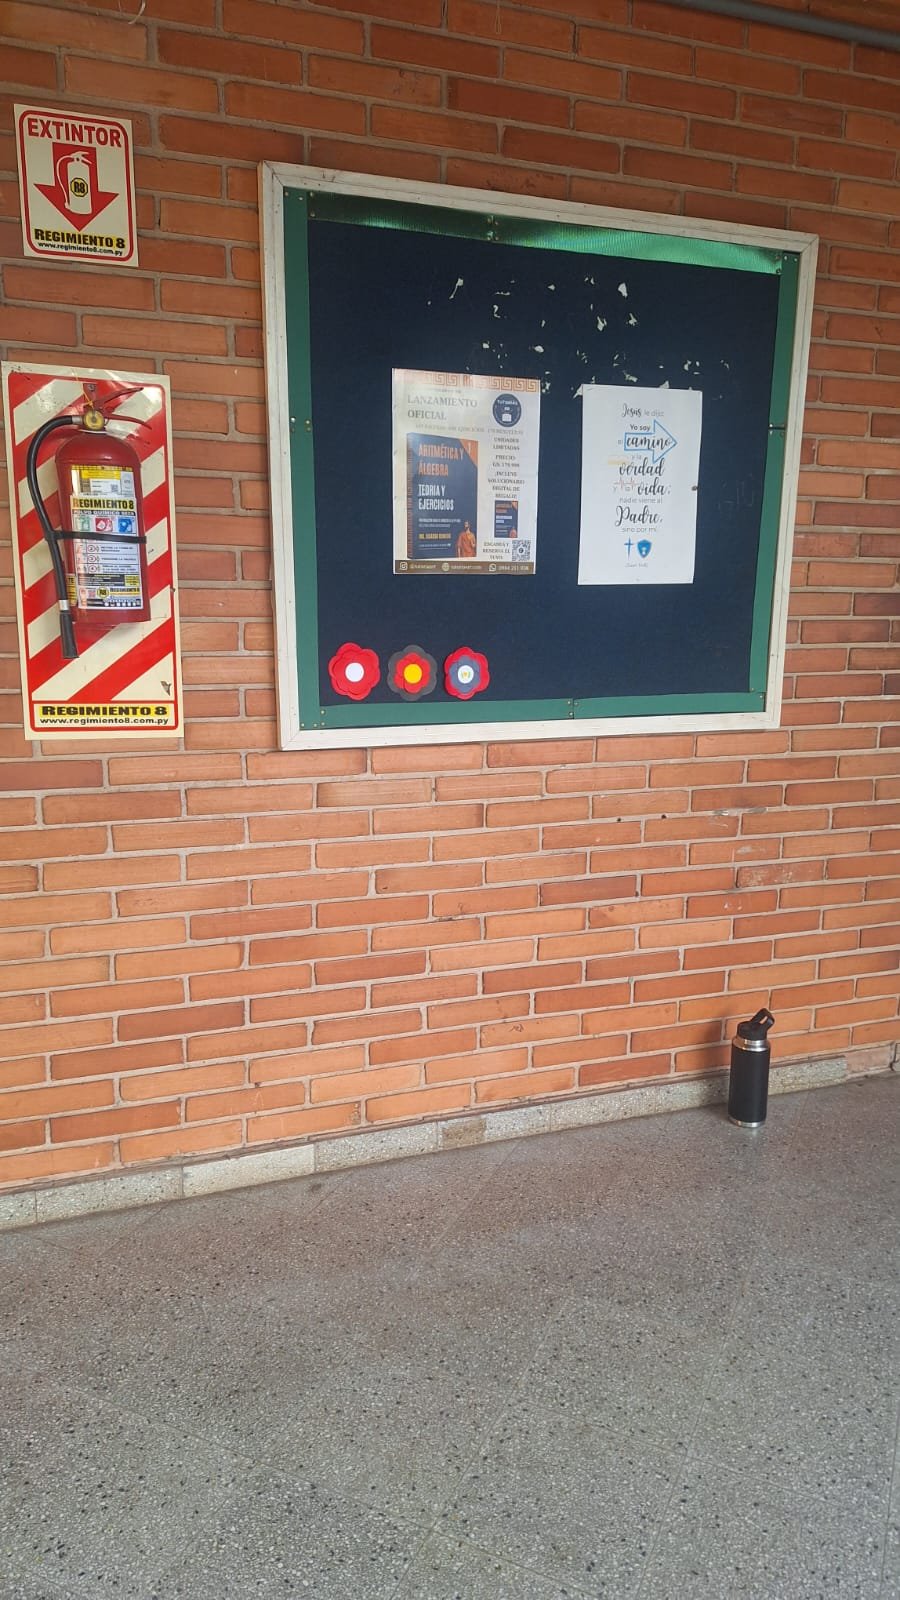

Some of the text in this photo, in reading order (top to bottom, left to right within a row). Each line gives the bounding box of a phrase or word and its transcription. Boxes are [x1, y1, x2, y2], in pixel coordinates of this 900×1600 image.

[27, 118, 122, 148] EXTINTOR
[73, 181, 86, 194] R8
[34, 228, 125, 249] REGIMIENTO 8
[38, 241, 123, 257] www.regimiento8.com.py
[407, 394, 478, 408] LANZAMIENTO
[407, 409, 447, 420] OFICIAL
[630, 423, 651, 433] Yo soy
[626, 436, 672, 450] camino
[418, 443, 460, 460] ARITMÉTICA
[619, 456, 665, 476] verdad
[441, 485, 446, 496] Y
[73, 497, 134, 509] REGIMIENTO 8
[418, 498, 455, 511] EJERCICIOS
[42, 705, 168, 716] REGIMIENTO 8
[39, 717, 169, 726] www.regimiento8.com.py
